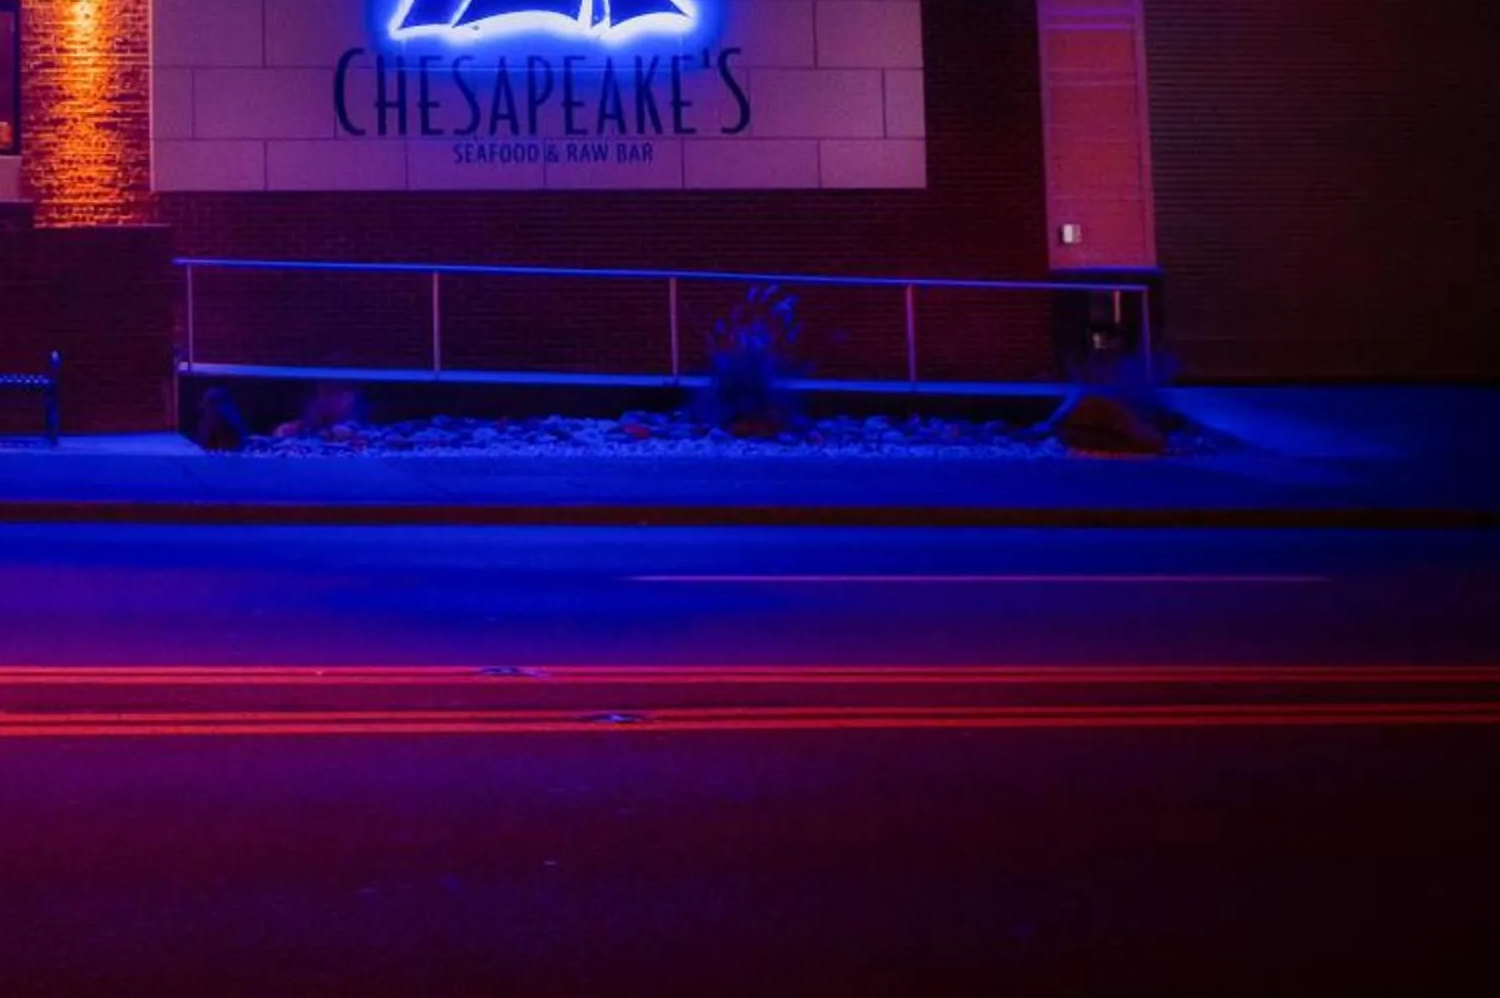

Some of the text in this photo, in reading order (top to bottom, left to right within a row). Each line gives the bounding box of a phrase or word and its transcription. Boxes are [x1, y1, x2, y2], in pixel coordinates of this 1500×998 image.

[334, 47, 750, 136] CHESAPEAKE'S
[453, 144, 654, 164] SEAFOOD & RAW BAR
